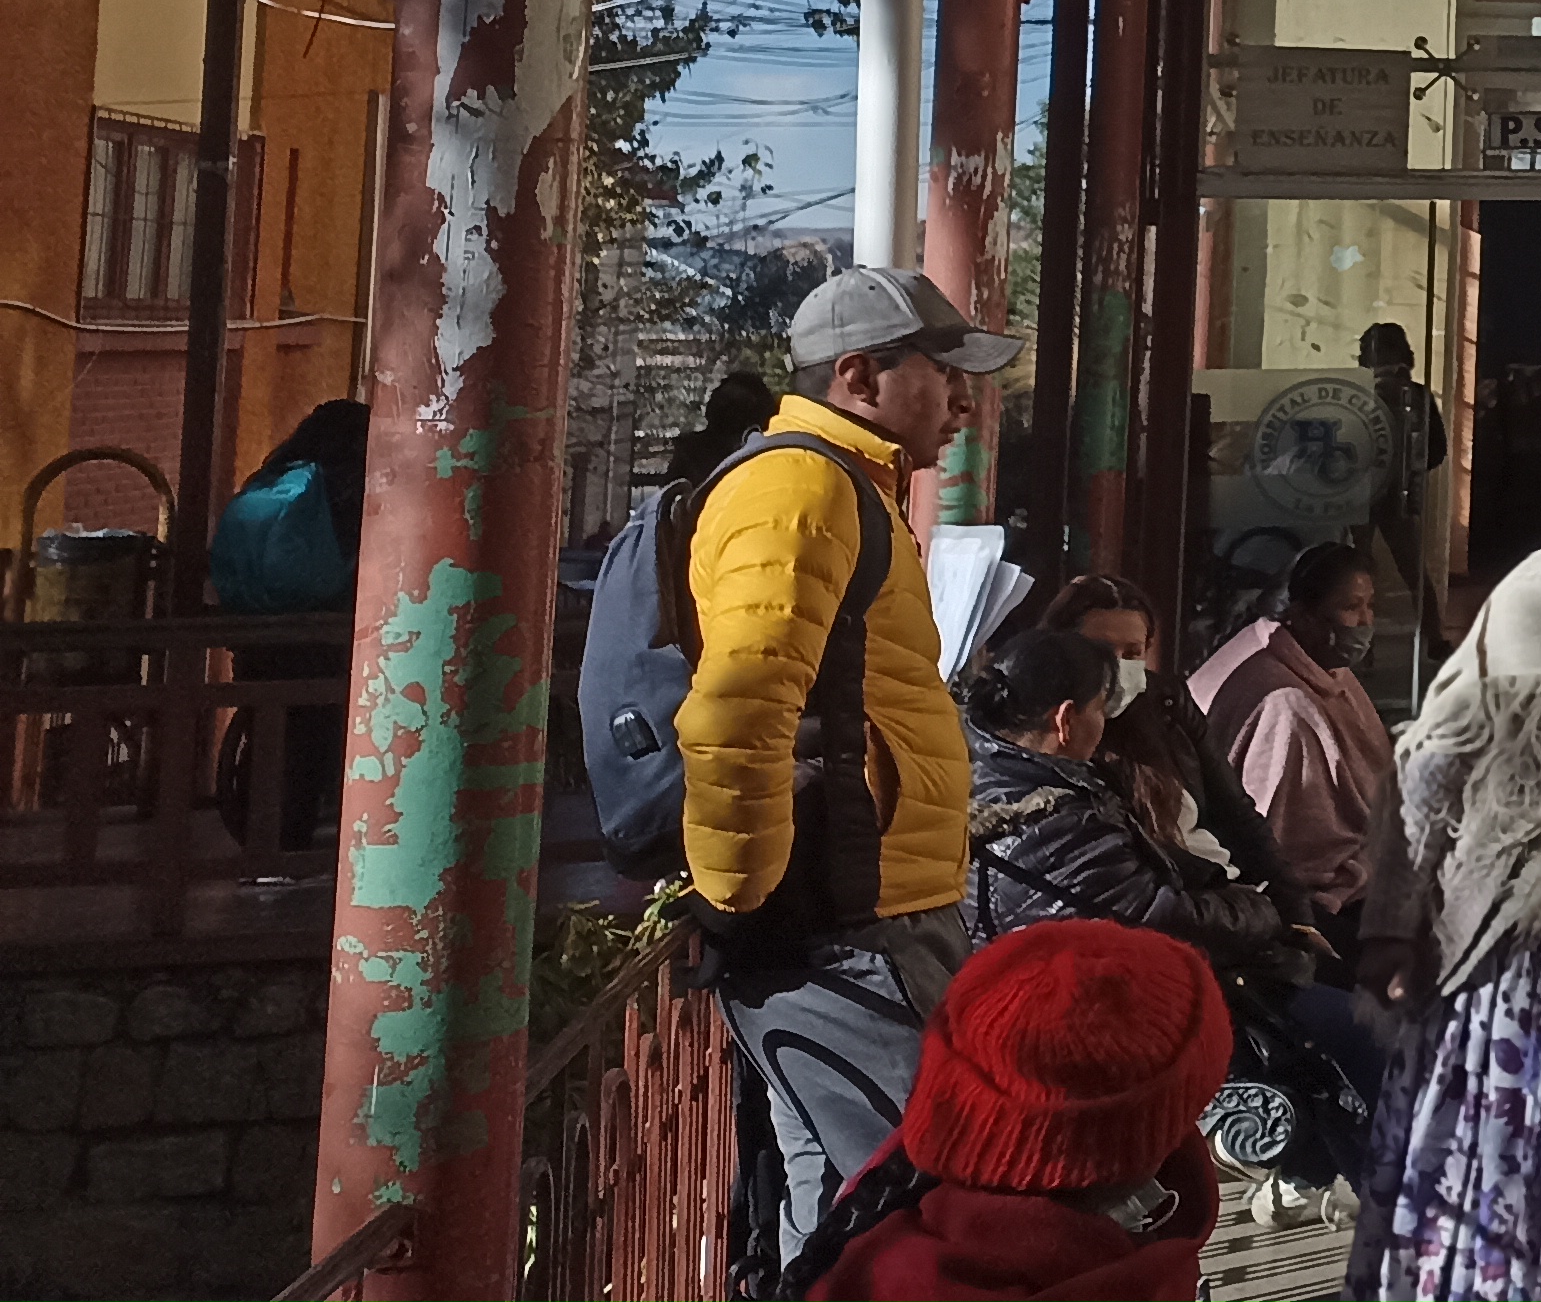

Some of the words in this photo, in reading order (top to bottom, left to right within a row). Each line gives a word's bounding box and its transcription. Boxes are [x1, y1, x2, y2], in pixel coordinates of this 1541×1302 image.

[1266, 65, 1390, 85] JEFATURA
[1312, 97, 1343, 116] DE
[1251, 126, 1397, 148] ENSEÑANZA
[1259, 391, 1311, 471] HOSPITAL
[1317, 386, 1343, 402] DE
